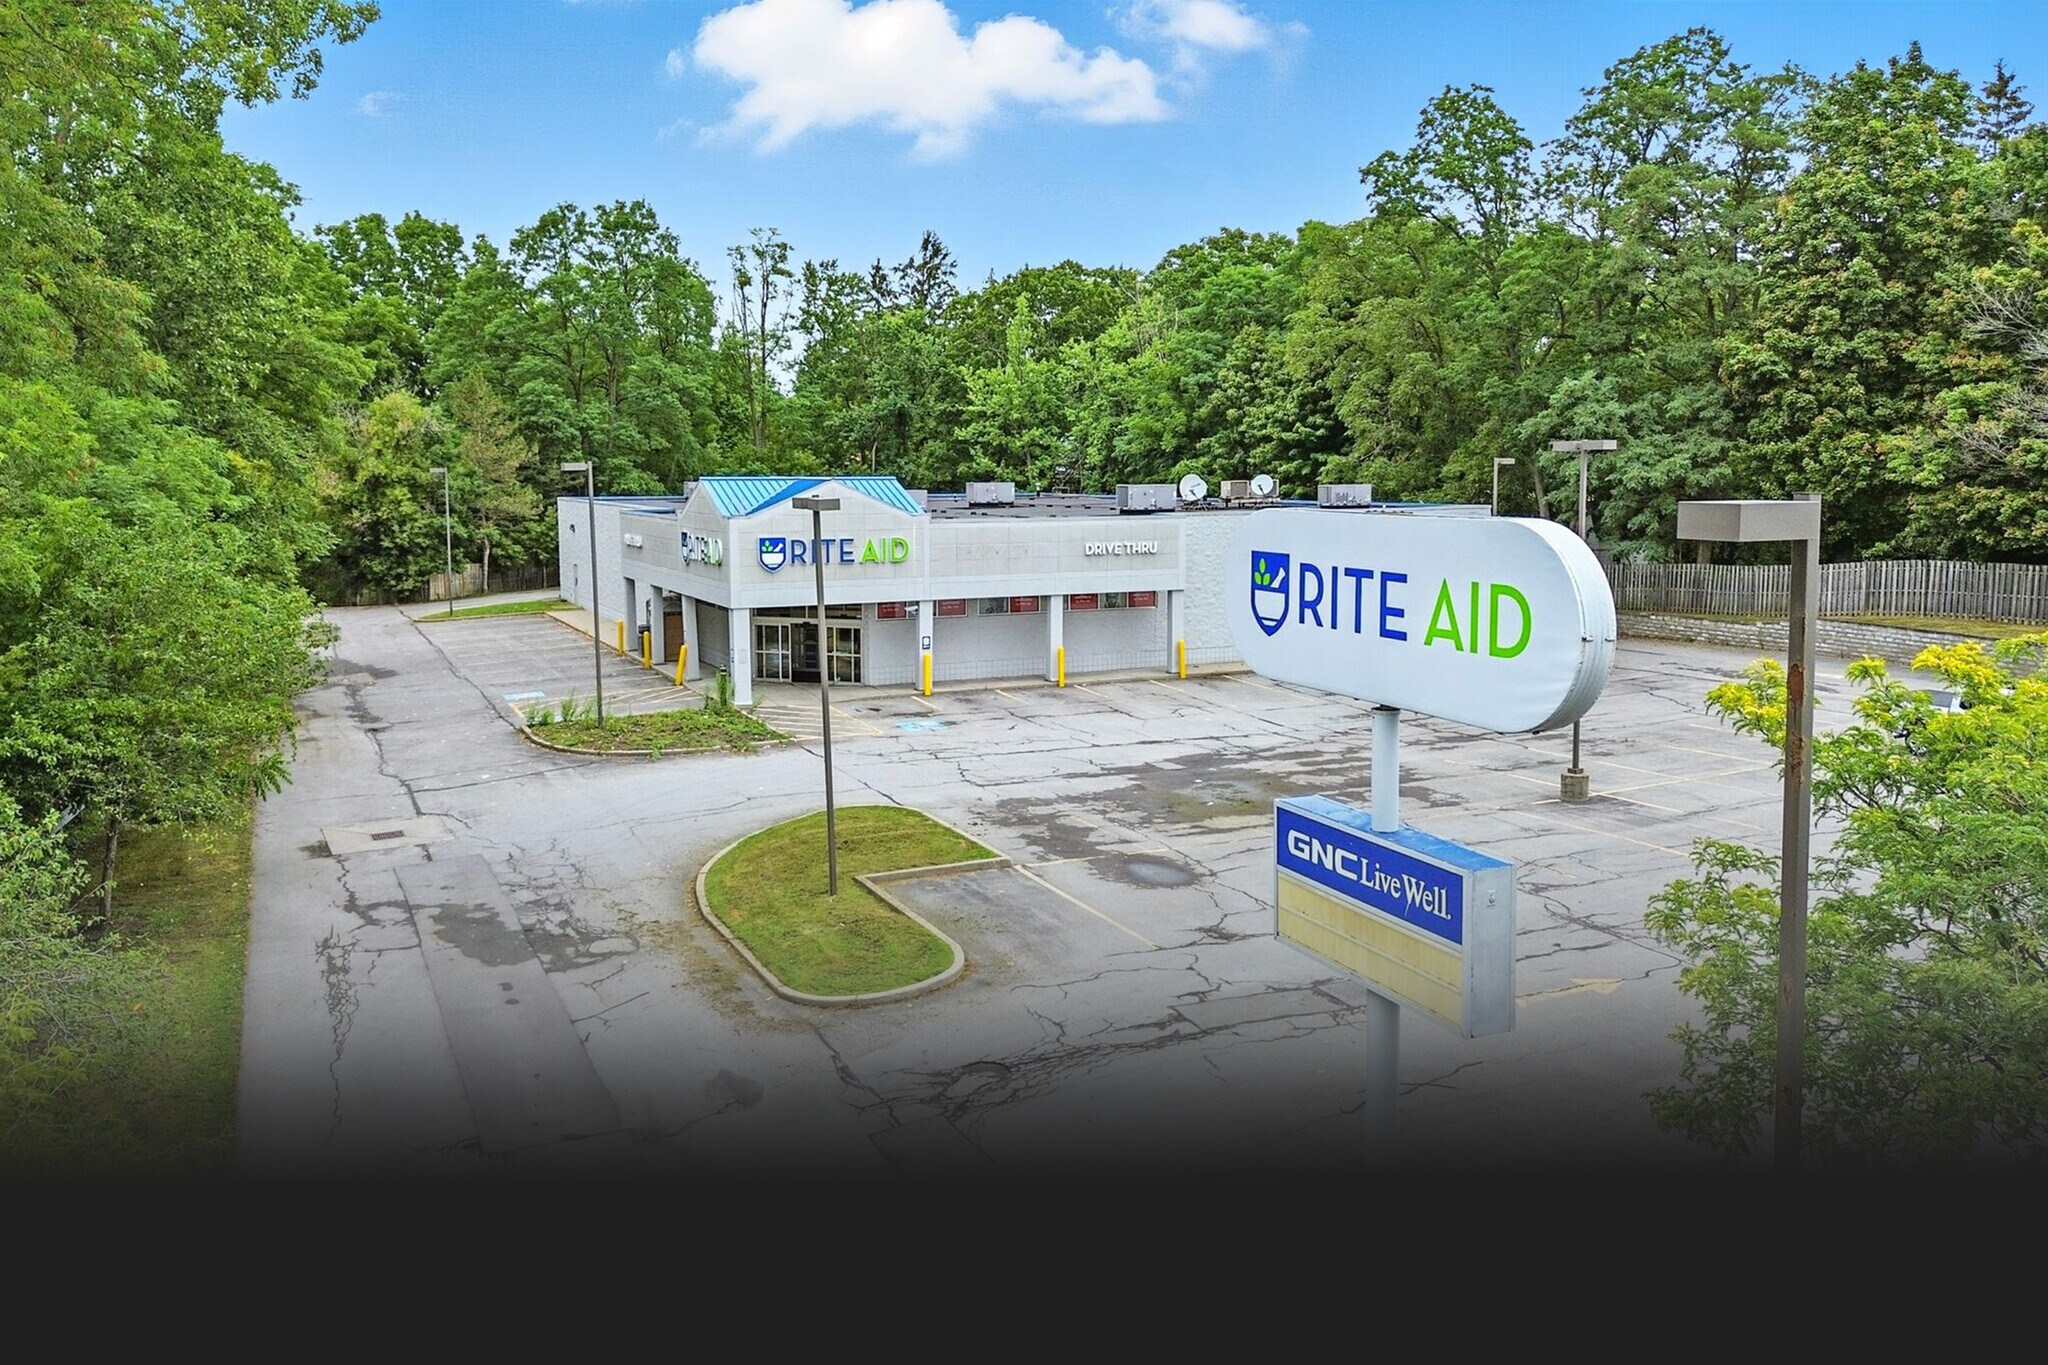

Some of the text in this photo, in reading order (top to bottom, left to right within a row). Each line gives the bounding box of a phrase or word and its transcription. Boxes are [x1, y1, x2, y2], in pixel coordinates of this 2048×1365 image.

[790, 535, 910, 565] RITE AID
[1085, 540, 1158, 556] DRIVE THRU
[1299, 562, 1532, 659] RITE AID
[1288, 829, 1358, 881] GNC
[1360, 857, 1401, 898] Live
